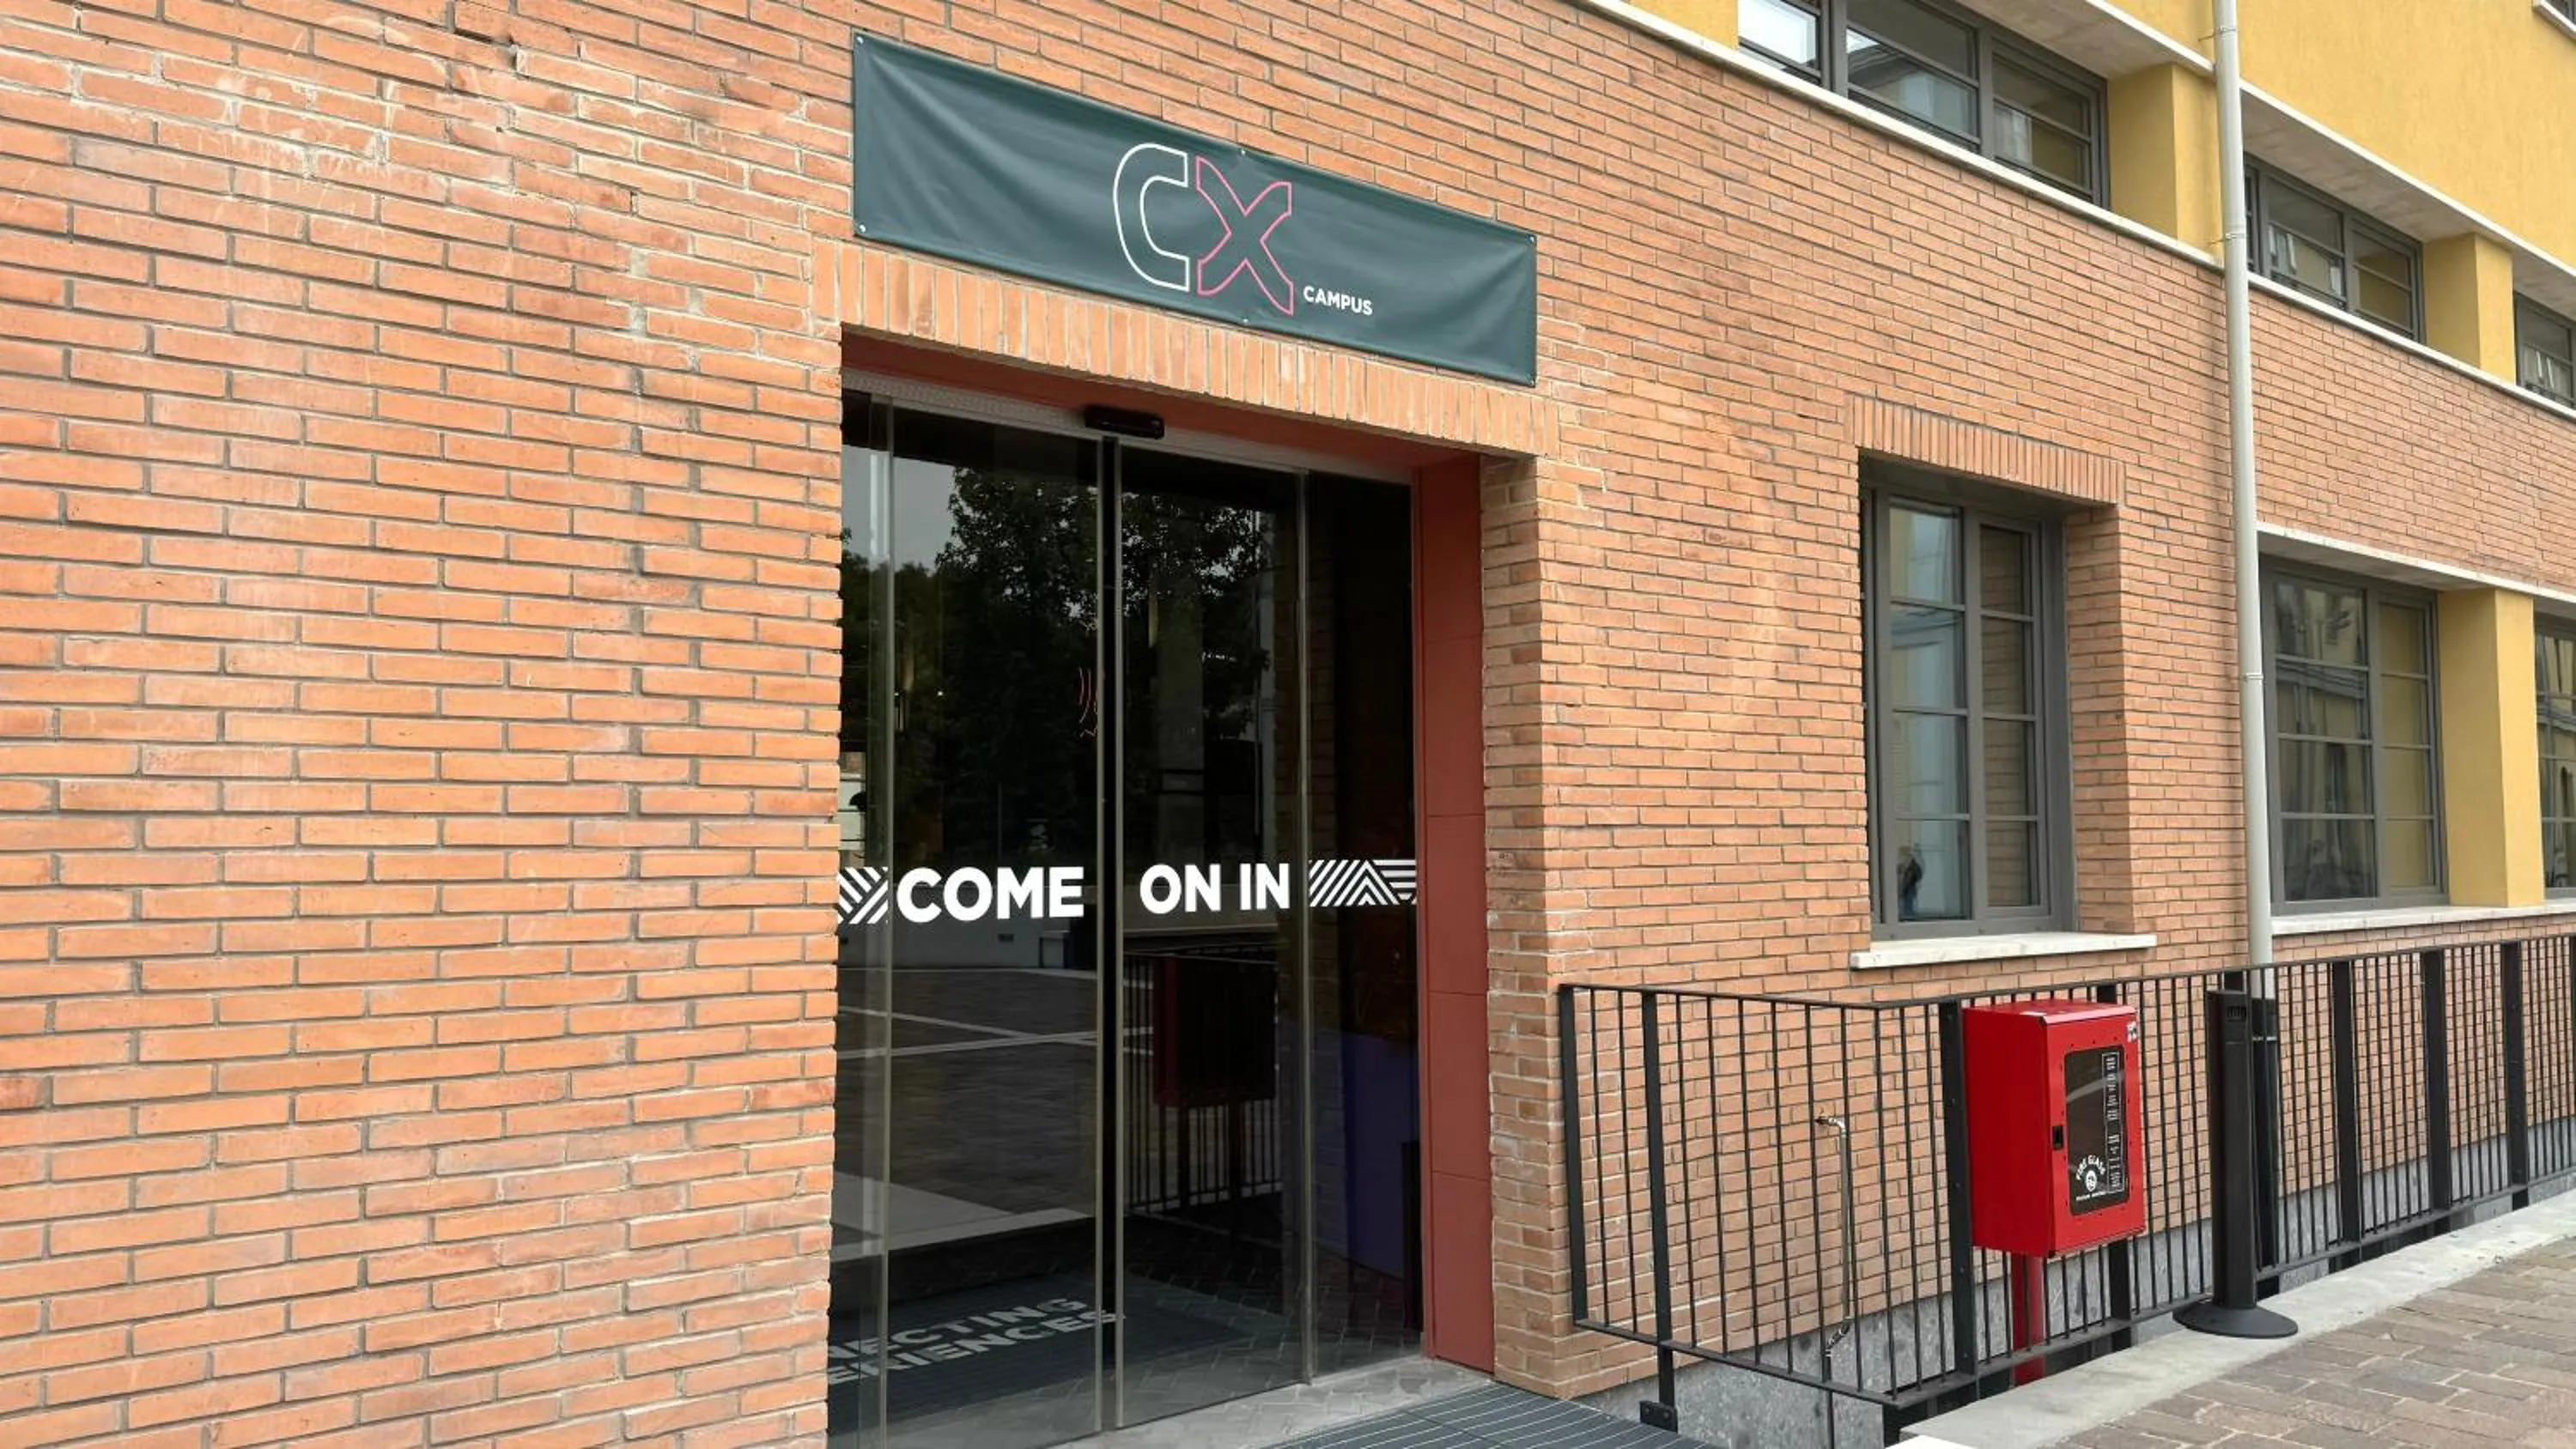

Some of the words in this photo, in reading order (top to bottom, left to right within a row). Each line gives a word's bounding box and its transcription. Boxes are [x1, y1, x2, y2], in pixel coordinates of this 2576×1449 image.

[1113, 142, 1294, 316] CX
[1303, 286, 1373, 316] CAMPUS
[896, 866, 1084, 923] COME
[1139, 864, 1222, 914] ON
[1240, 863, 1291, 911] IN
